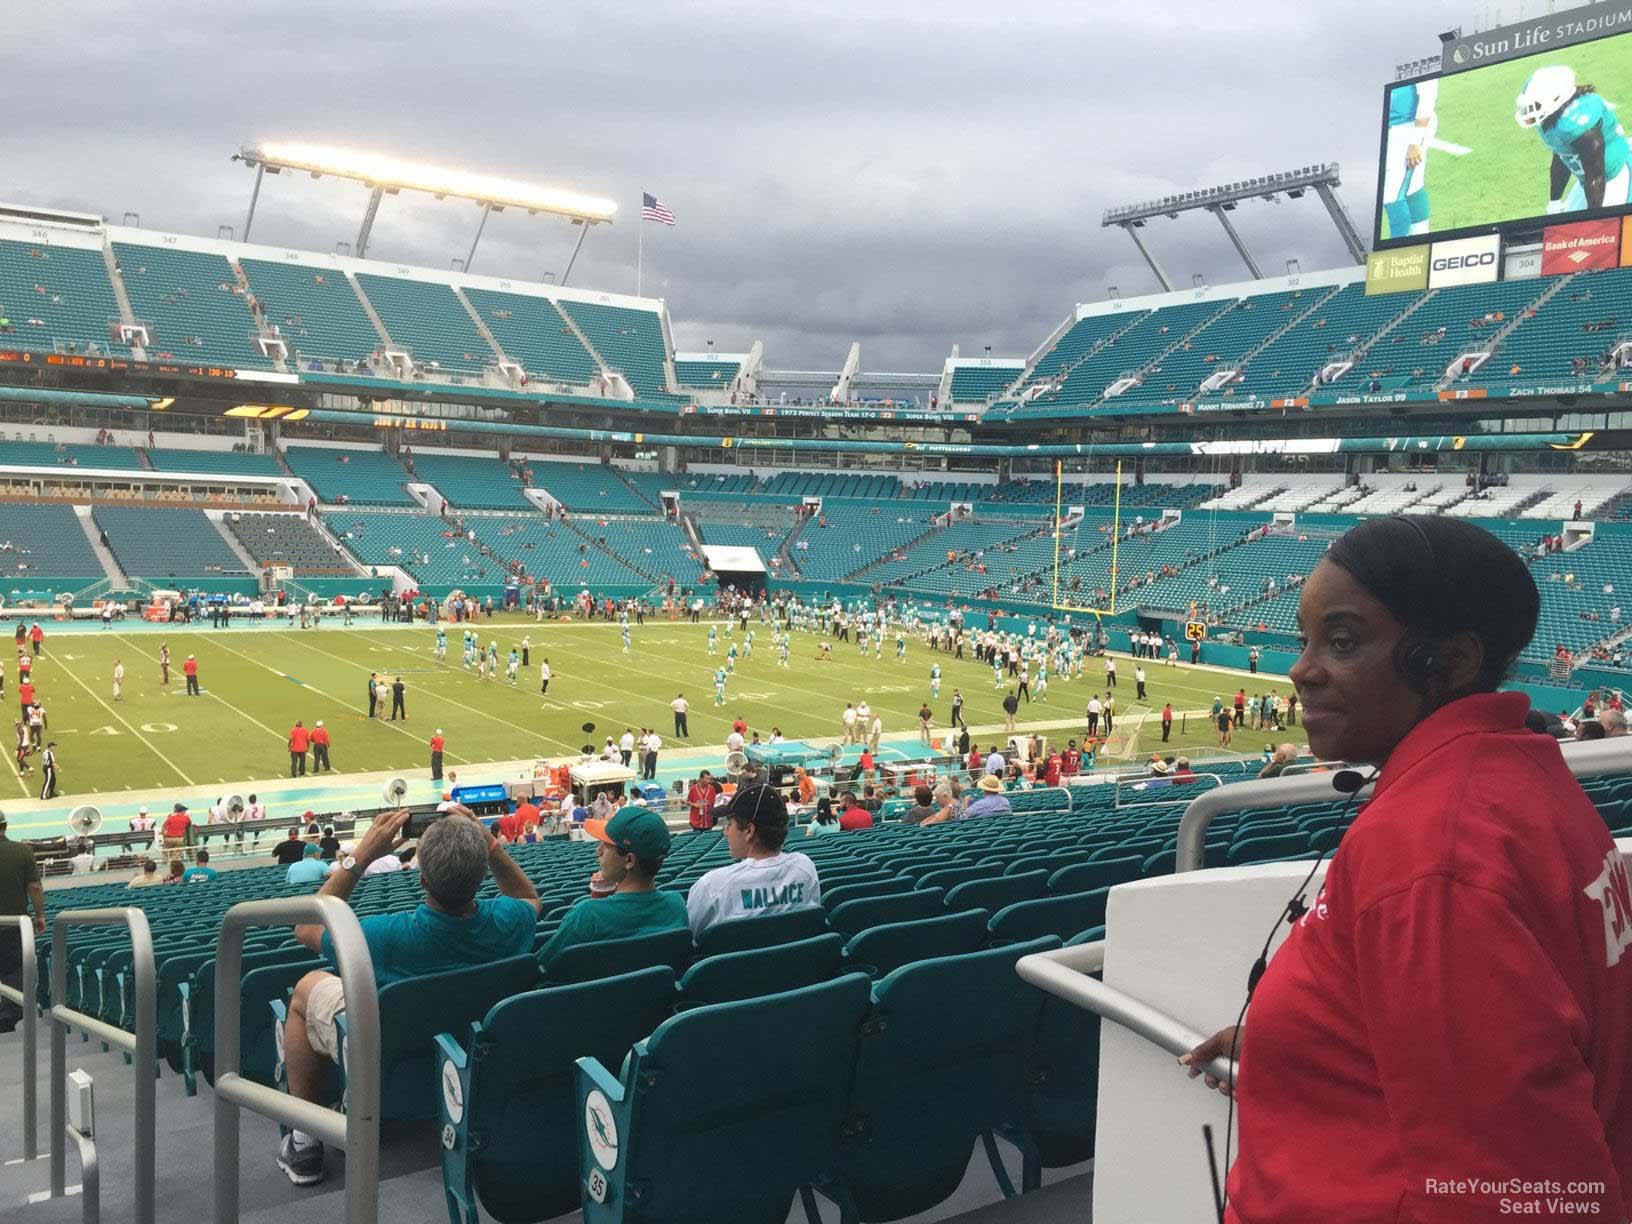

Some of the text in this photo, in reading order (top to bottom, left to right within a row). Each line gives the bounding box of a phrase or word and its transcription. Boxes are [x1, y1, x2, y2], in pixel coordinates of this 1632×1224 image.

[1472, 9, 1632, 60] Sun Life STADIUM
[1545, 234, 1616, 251] Bank of America
[1391, 255, 1423, 267] Baptist
[1433, 252, 1495, 271] GEICO
[1519, 259, 1535, 269] 304
[1390, 265, 1422, 278] Health
[1578, 384, 1592, 393] 54
[1395, 393, 1407, 402] 99
[1188, 624, 1203, 639] 25
[252, 807, 258, 818] 2
[741, 882, 804, 909] WALLACE
[445, 1127, 454, 1144] 34
[592, 1174, 604, 1196] 35
